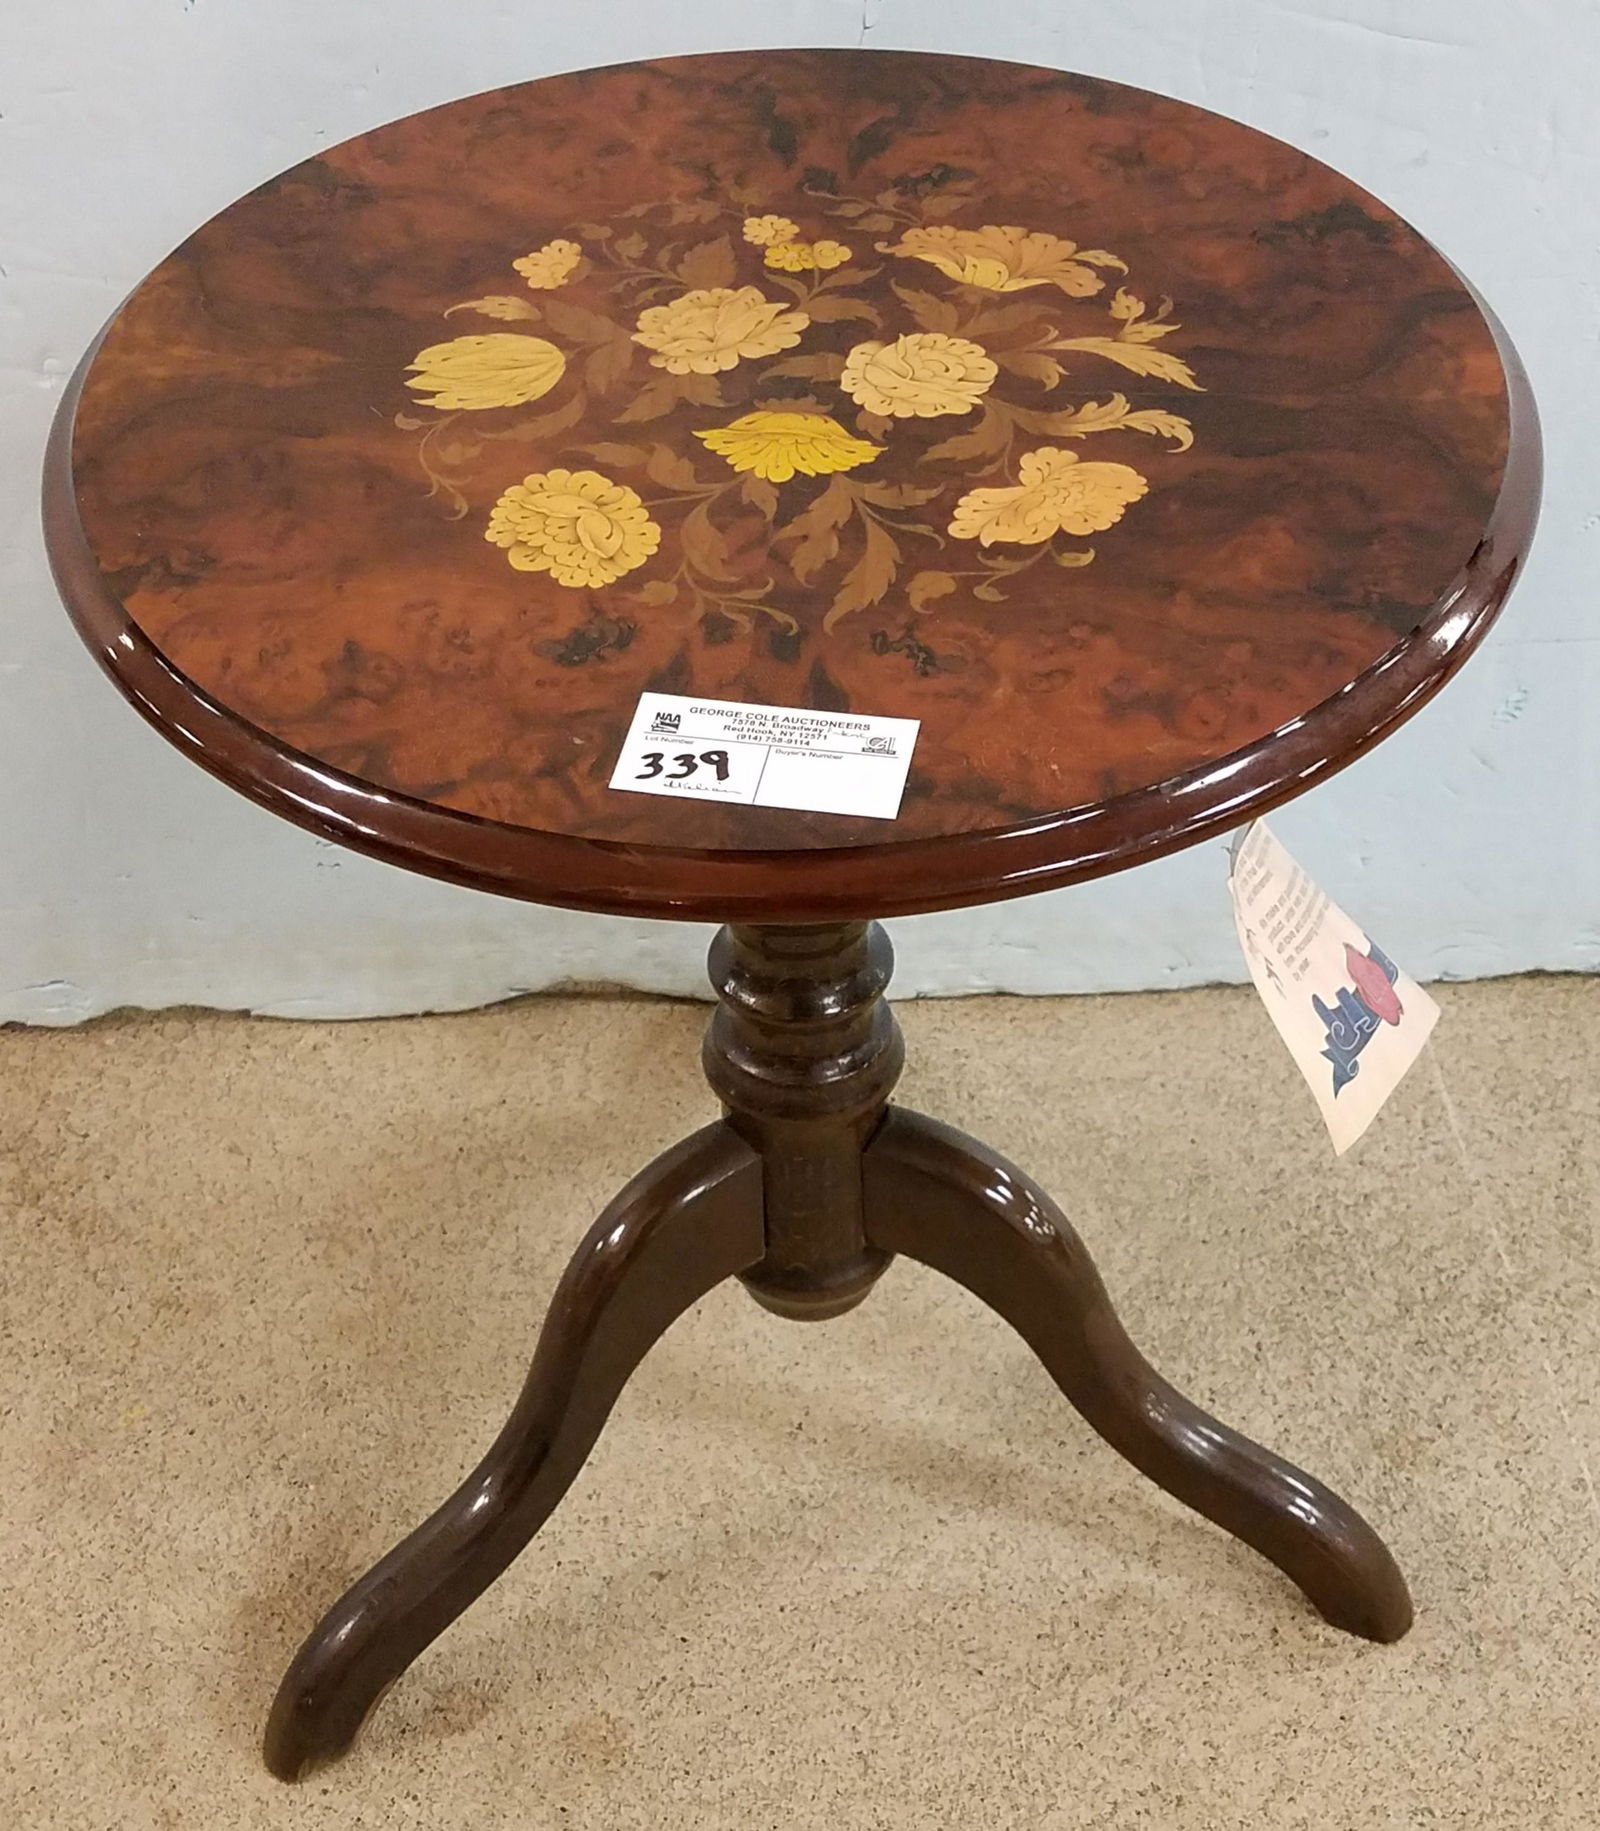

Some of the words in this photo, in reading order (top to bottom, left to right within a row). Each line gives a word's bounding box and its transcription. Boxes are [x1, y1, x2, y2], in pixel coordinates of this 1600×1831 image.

[654, 711, 681, 723] NAA
[690, 706, 743, 718] GEORGE
[745, 712, 780, 722] COLE
[782, 715, 871, 731] AUCTIONEERS
[723, 724, 745, 732] Red
[747, 727, 776, 736] Hook,
[799, 731, 828, 741] 12571
[772, 722, 825, 734] Broadway
[660, 736, 695, 745] Number
[736, 733, 763, 742] (914)
[765, 736, 811, 747] 758-9114
[775, 748, 806, 757] Buyer's
[808, 751, 844, 760] Number
[634, 750, 730, 781] 339
